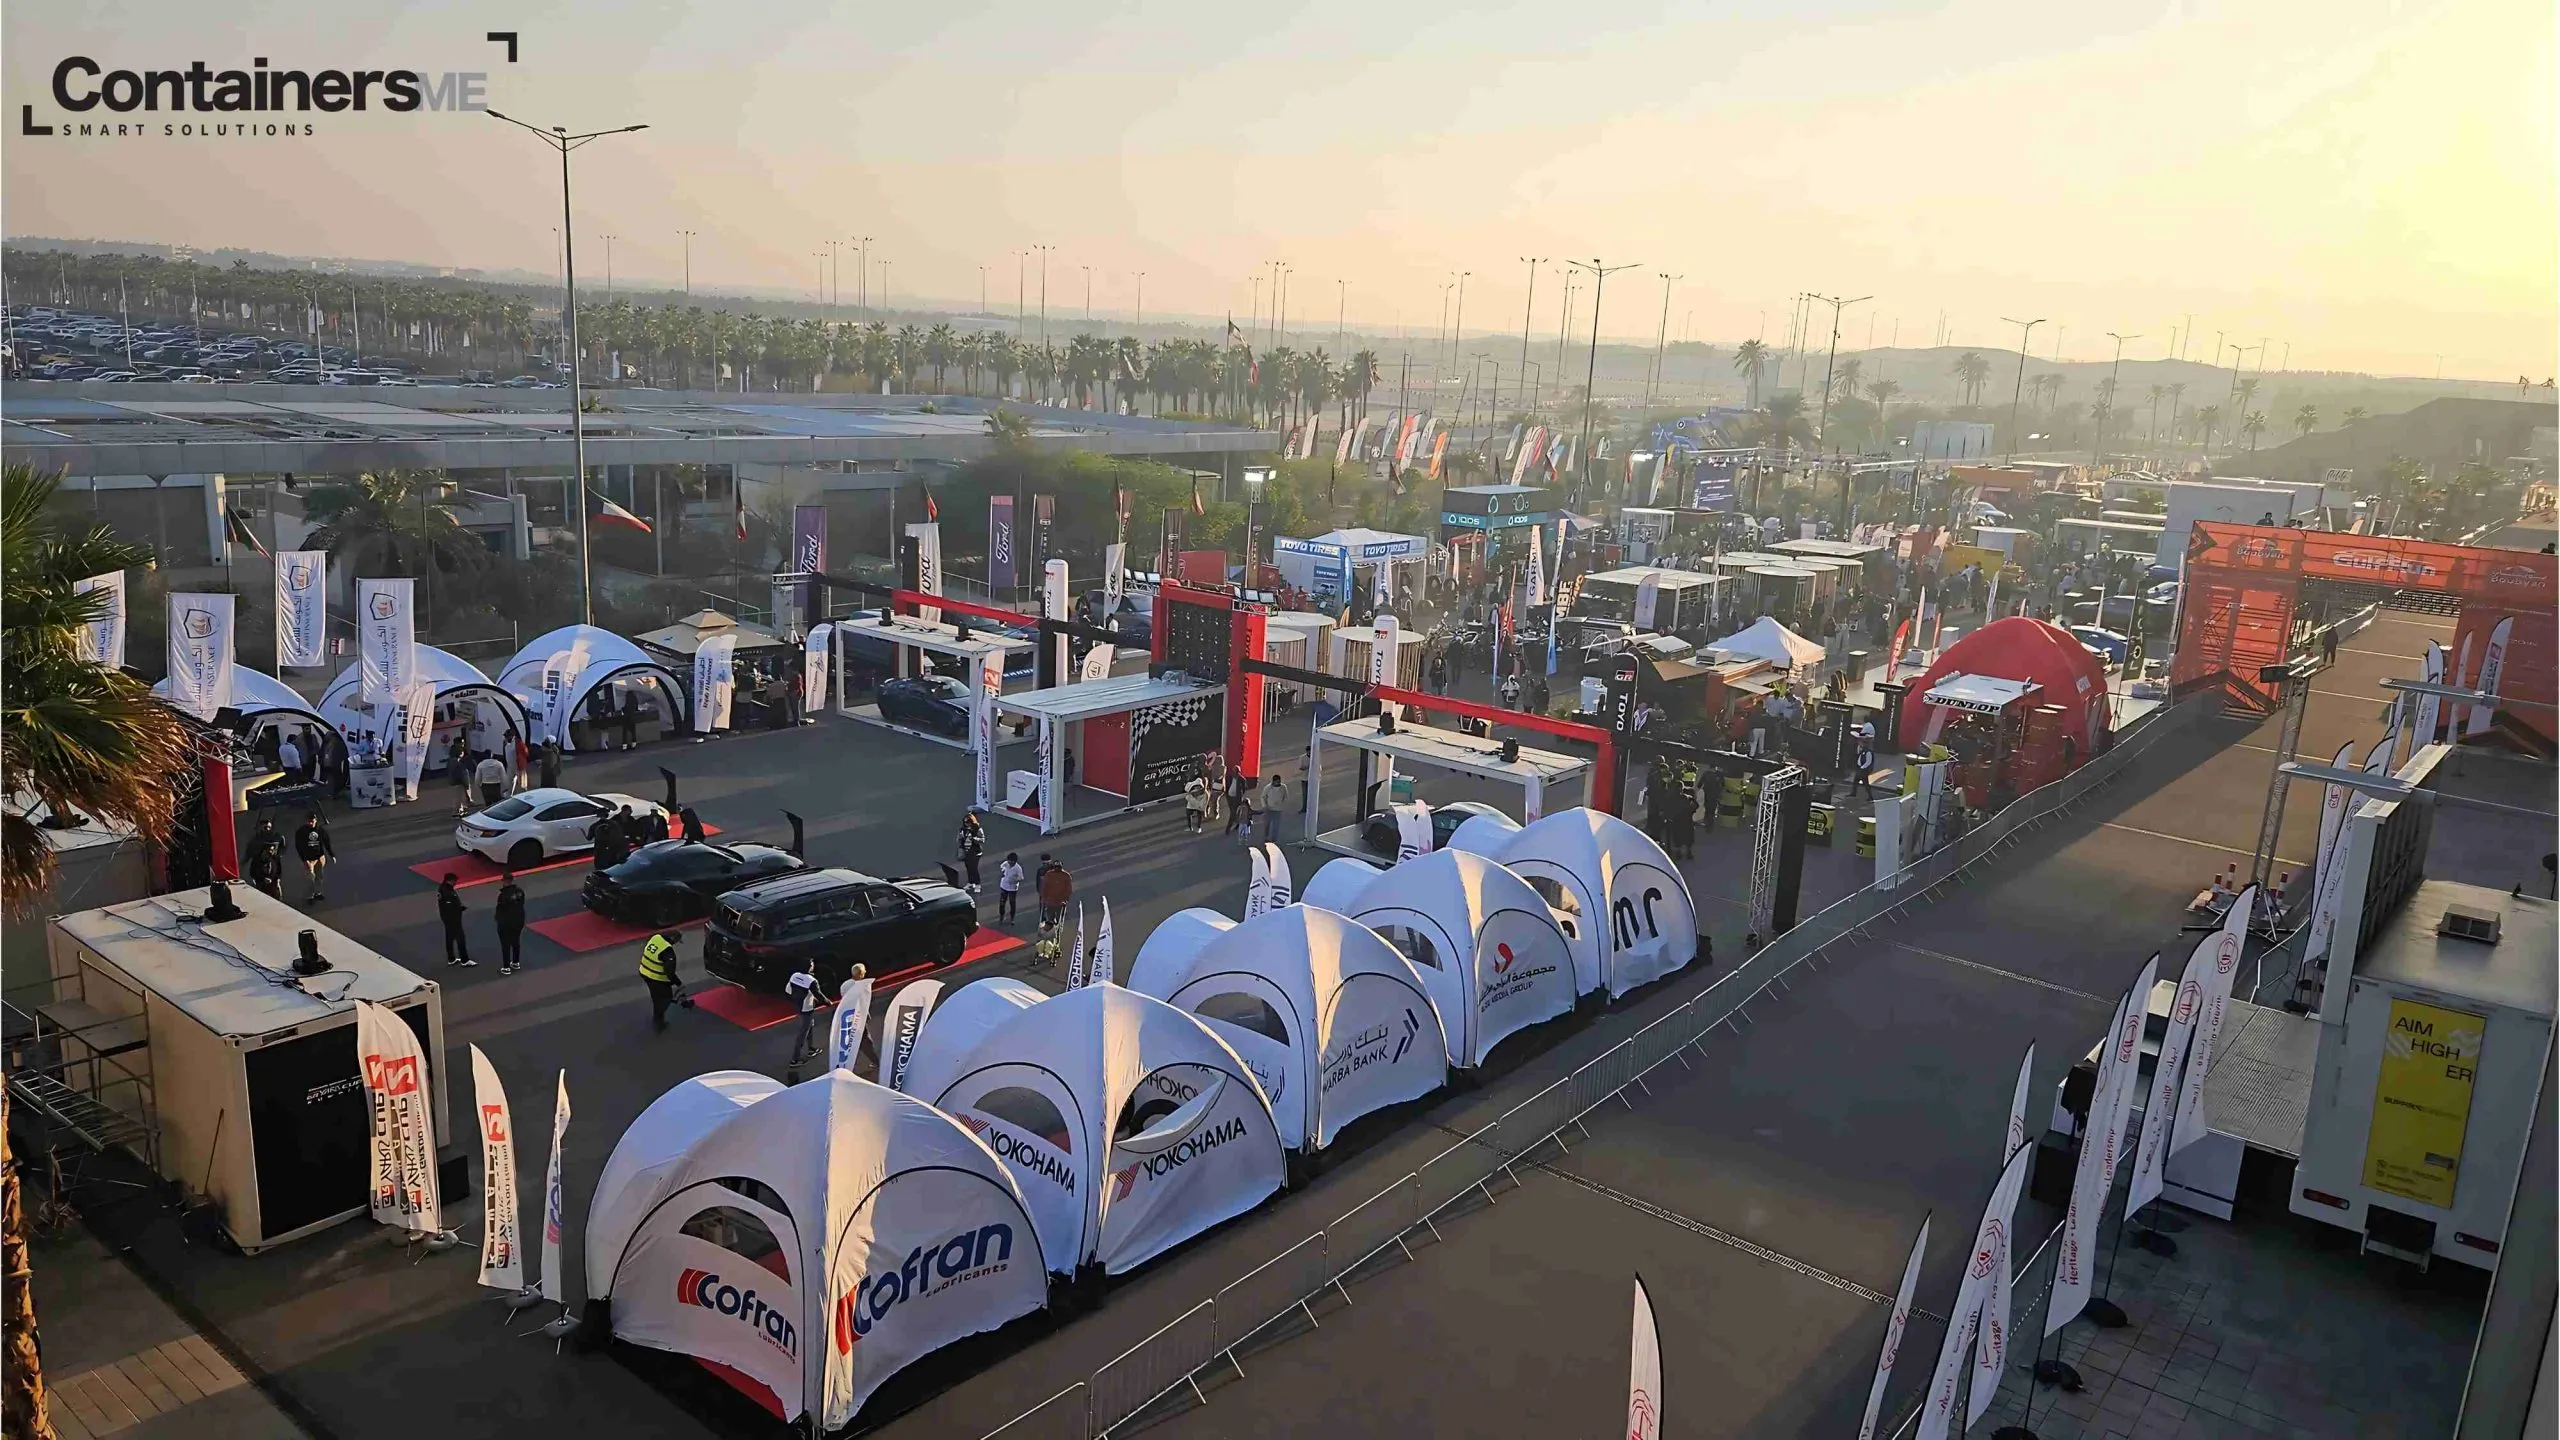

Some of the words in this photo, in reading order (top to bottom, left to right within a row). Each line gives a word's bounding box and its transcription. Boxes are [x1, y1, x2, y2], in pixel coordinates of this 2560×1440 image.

[1458, 517, 1480, 525] IQOS
[996, 521, 1011, 564] Ford
[1280, 539, 1306, 551] TOYO
[1308, 543, 1340, 556] TIRES
[1365, 545, 1386, 556] TOYO
[1386, 542, 1409, 553] TIRES
[1615, 670, 1635, 681] GR
[1936, 696, 2001, 713] DUNLOP
[1144, 772, 1156, 781] GR
[1158, 764, 1180, 778] YARIS
[1510, 981, 1534, 995] GROUP
[2395, 1016, 2434, 1038] AIM
[893, 1010, 917, 1090] YOKOHAMA
[1354, 1044, 1388, 1072] BANK
[2410, 1038, 2460, 1061] HIGH
[2445, 1064, 2473, 1083] ER
[1143, 1116, 1247, 1182] YOKOHAMA
[2104, 1127, 2117, 1181] Leadership
[989, 1127, 1075, 1197] YOKOHAMA
[2068, 1239, 2079, 1286] Heritage
[853, 1223, 1013, 1335] Cofran
[697, 1274, 797, 1357] Cofran
